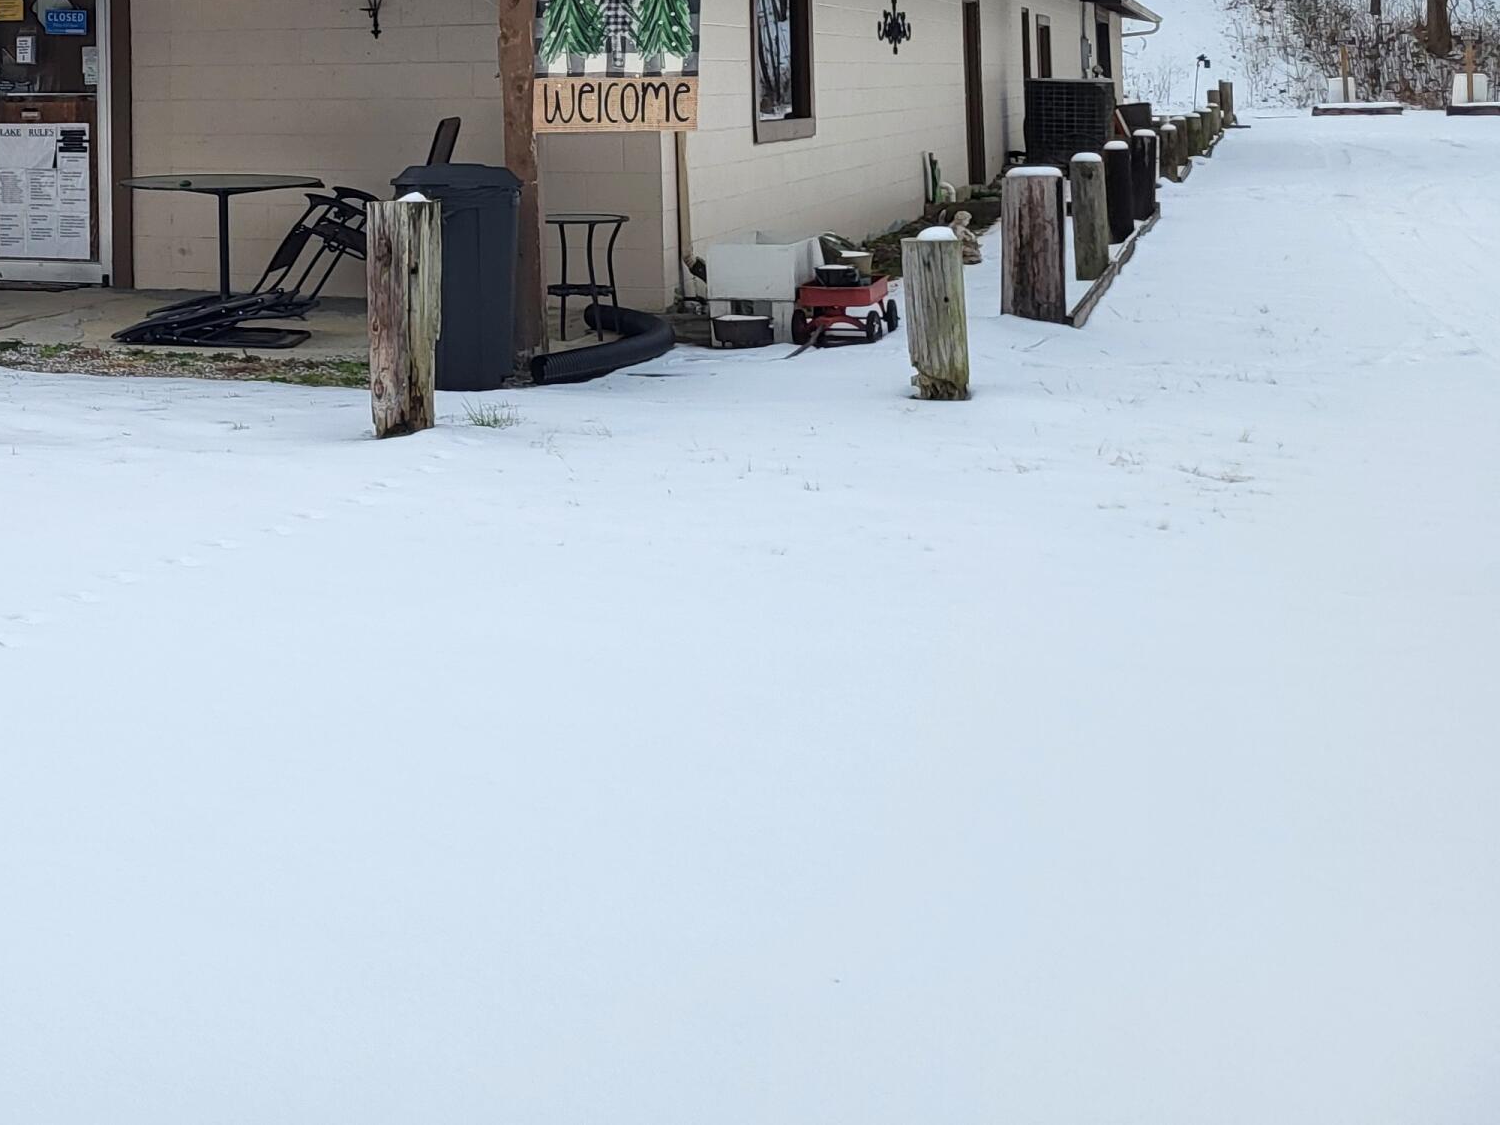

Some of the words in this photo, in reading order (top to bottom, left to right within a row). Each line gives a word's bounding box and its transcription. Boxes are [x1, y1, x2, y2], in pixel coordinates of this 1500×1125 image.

[47, 12, 84, 22] CLOSED
[0, 128, 21, 137] LAKE
[28, 128, 55, 138] RULES
